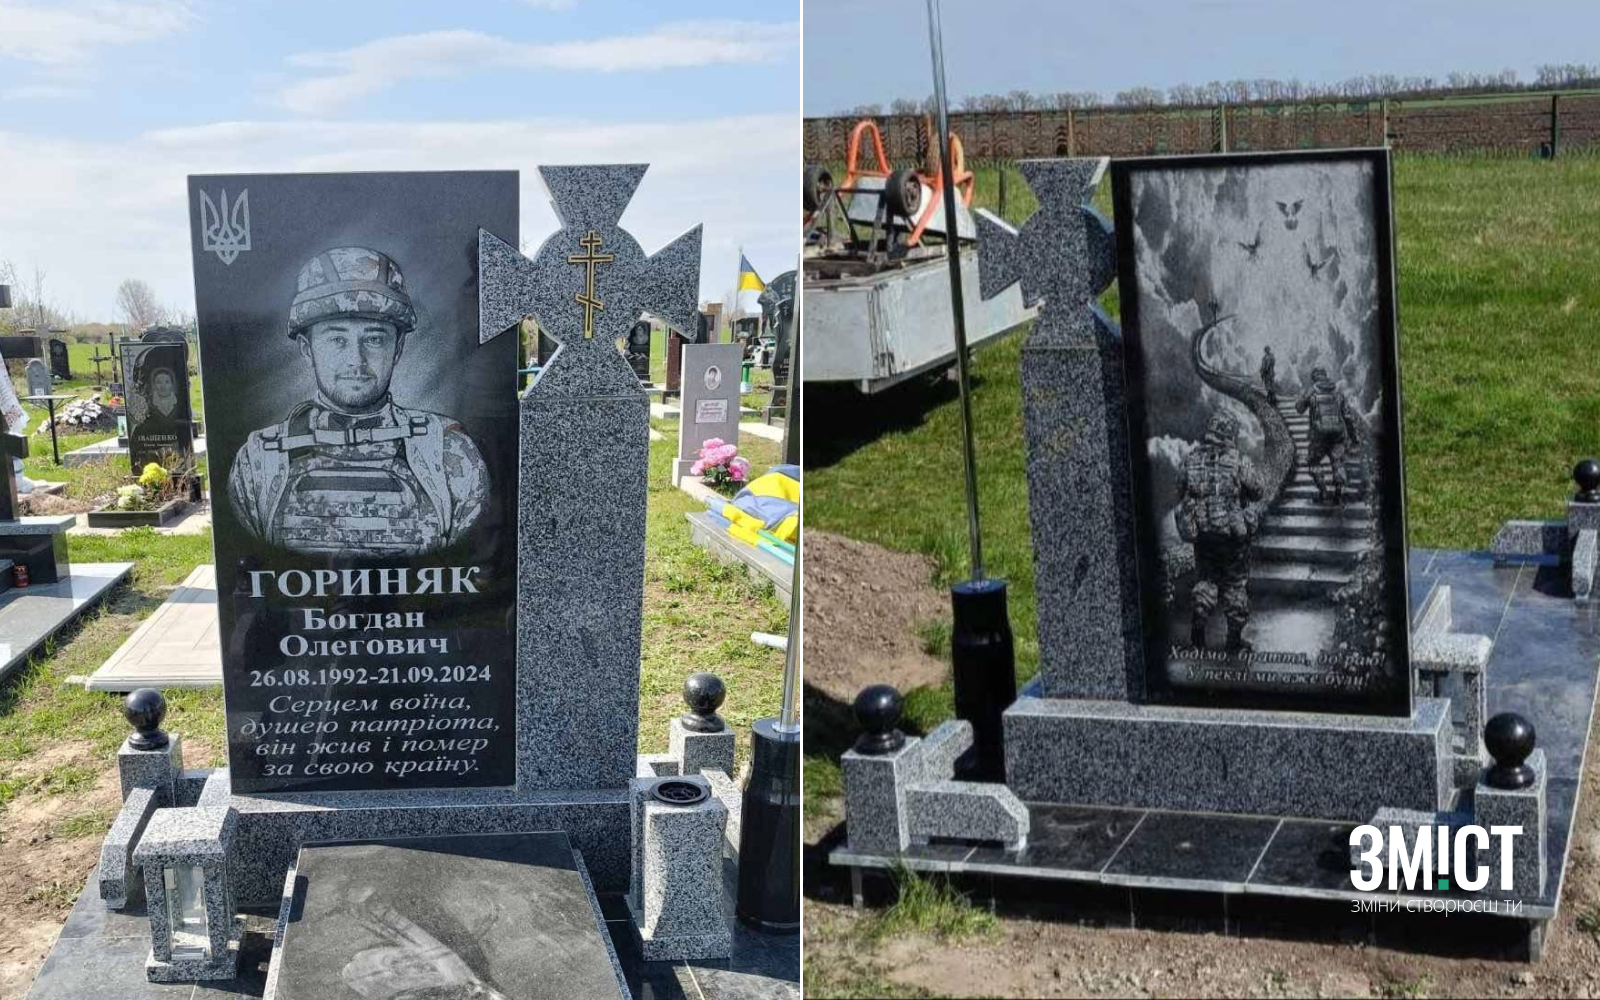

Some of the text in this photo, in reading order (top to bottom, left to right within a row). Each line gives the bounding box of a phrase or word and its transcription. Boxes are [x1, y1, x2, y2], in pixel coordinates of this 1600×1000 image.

[248, 566, 481, 598] ГОРИНЯК
[302, 608, 425, 632] Богдан
[279, 634, 449, 657] Олегович
[1168, 645, 1231, 662] Ходімо,
[250, 665, 492, 687] 26.08.1992-21.09.2024
[1187, 662, 1370, 689] У пеклі ми вже були!
[269, 693, 471, 717] Серцем воїна,
[240, 714, 500, 739] душею патріота,
[255, 737, 489, 757] він жив і помер
[263, 756, 480, 777] за свою країну.
